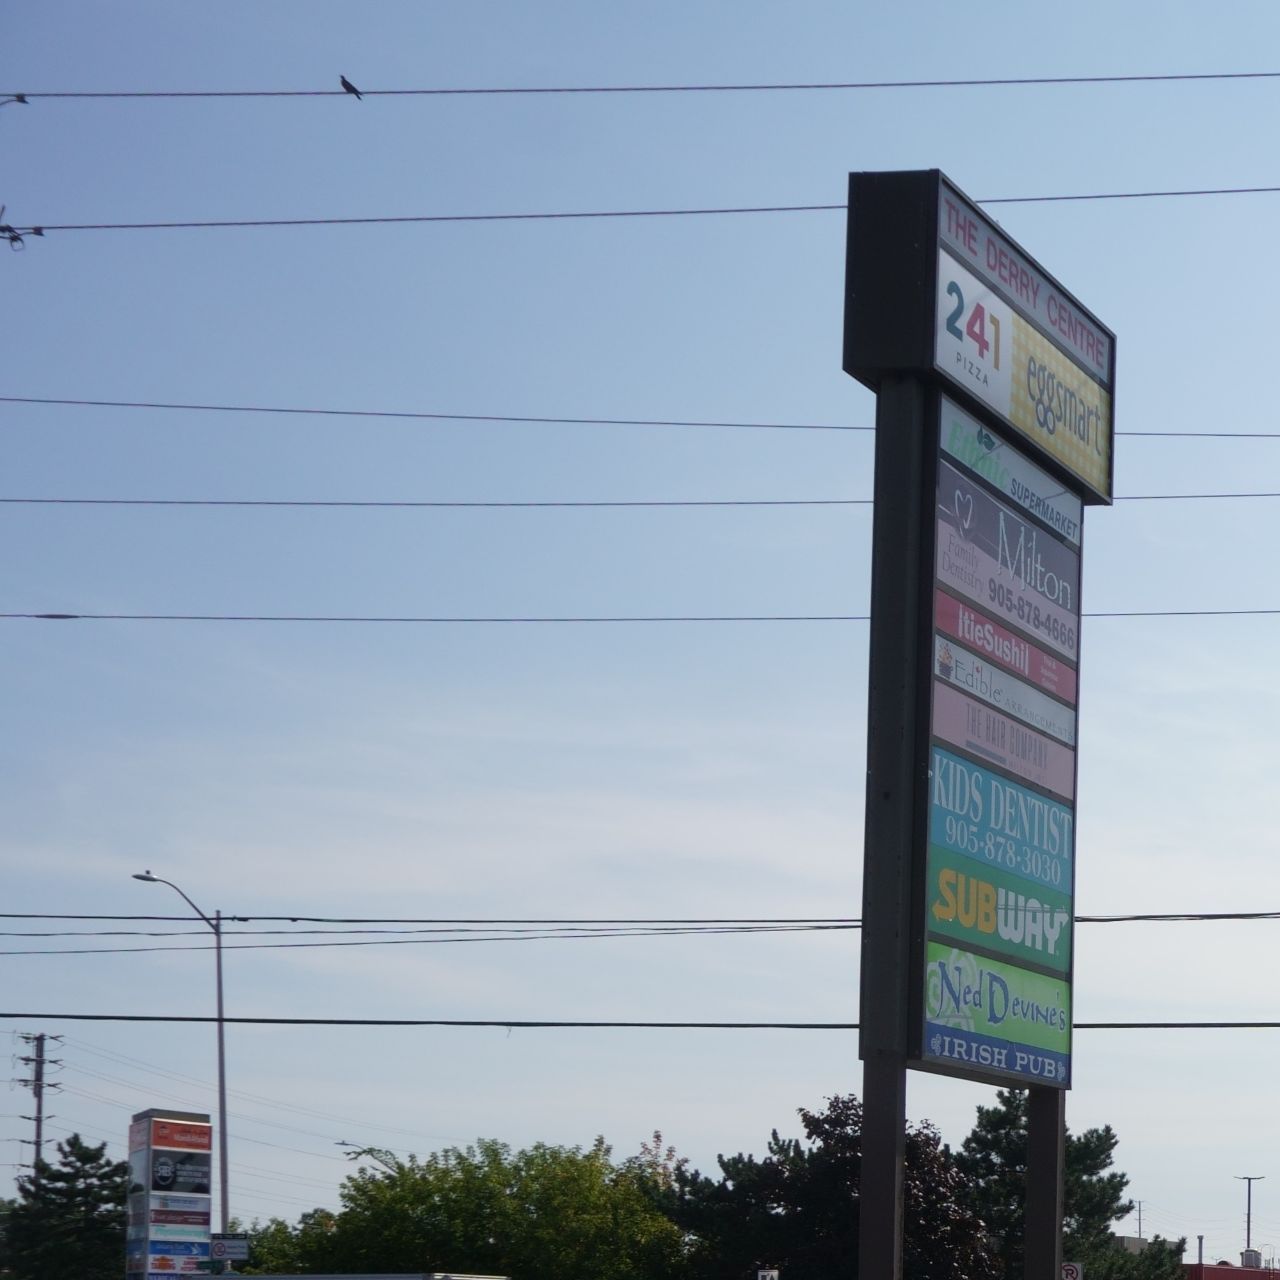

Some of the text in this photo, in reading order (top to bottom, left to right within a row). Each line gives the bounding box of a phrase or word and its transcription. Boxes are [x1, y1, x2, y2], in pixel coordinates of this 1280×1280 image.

[944, 197, 1105, 370] THE DERRY CENTRE
[946, 280, 1000, 372] 241
[956, 351, 989, 387] PIZZA
[1027, 355, 1101, 457] eggsmart
[1010, 478, 1078, 540] SUPERMARKET
[997, 511, 1071, 609] Milton
[988, 577, 1074, 650] 905-878-4666
[954, 657, 1001, 704] Edible
[966, 702, 982, 739] THE
[985, 712, 1006, 750] HAIR
[934, 754, 1072, 860] KIDS DENTIST
[932, 867, 1070, 955] SUBWAY
[936, 961, 983, 1018] Ned
[942, 1036, 1057, 1079] IRISH PUB
